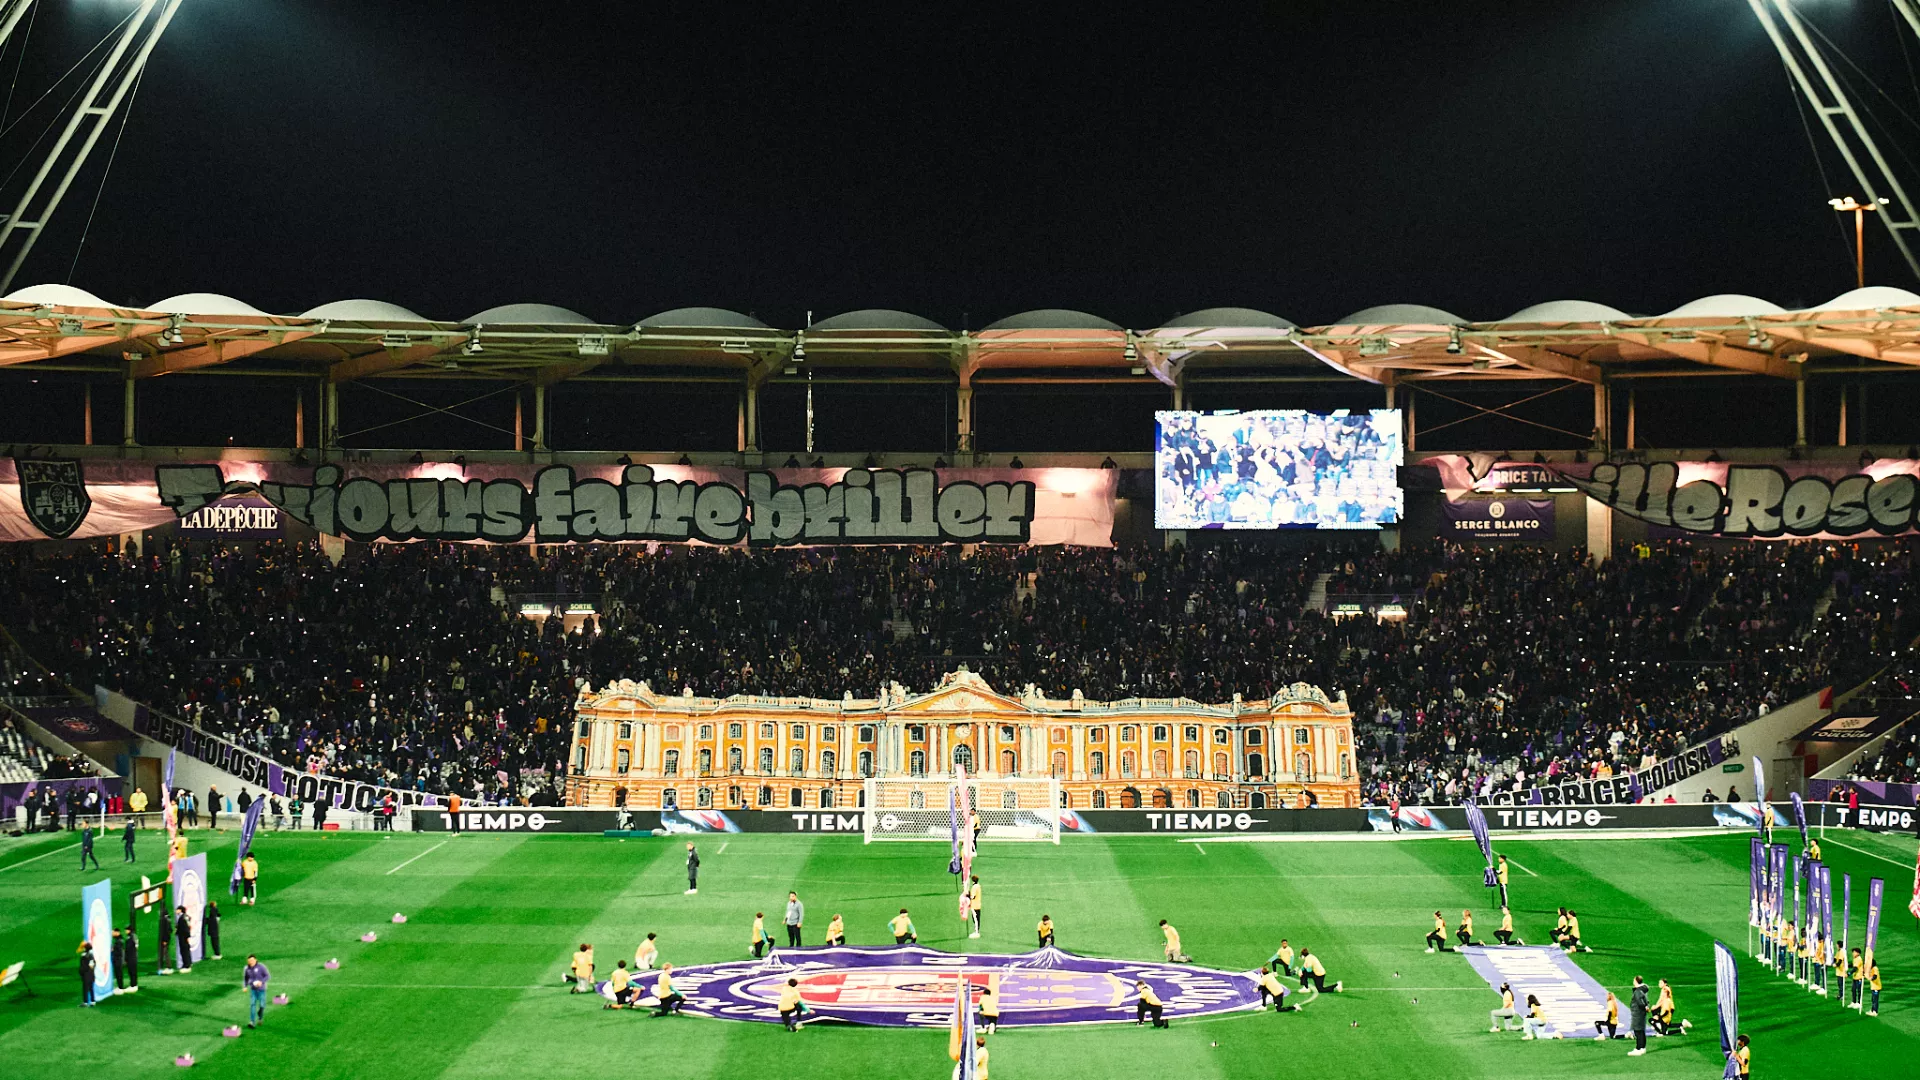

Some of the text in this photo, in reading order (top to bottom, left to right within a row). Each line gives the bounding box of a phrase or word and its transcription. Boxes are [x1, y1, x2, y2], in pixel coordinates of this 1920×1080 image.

[1493, 470, 1528, 483] BRICE
[534, 463, 746, 543] faire
[747, 467, 1036, 543] briller
[1583, 461, 1918, 537] ille Rose
[203, 504, 278, 529] DÉPÊCHE
[1455, 520, 1540, 529] SERGE BLANCO
[190, 729, 269, 790] TOLOSA
[1540, 776, 1634, 805] BRICE
[1637, 743, 1713, 796] TOLOSA
[440, 813, 546, 830] TIEMPO
[792, 813, 898, 831] TIEMO
[1146, 813, 1252, 830] TIEMPO
[1498, 809, 1601, 827] TIEMPO
[1836, 808, 1911, 828] TEMPO
